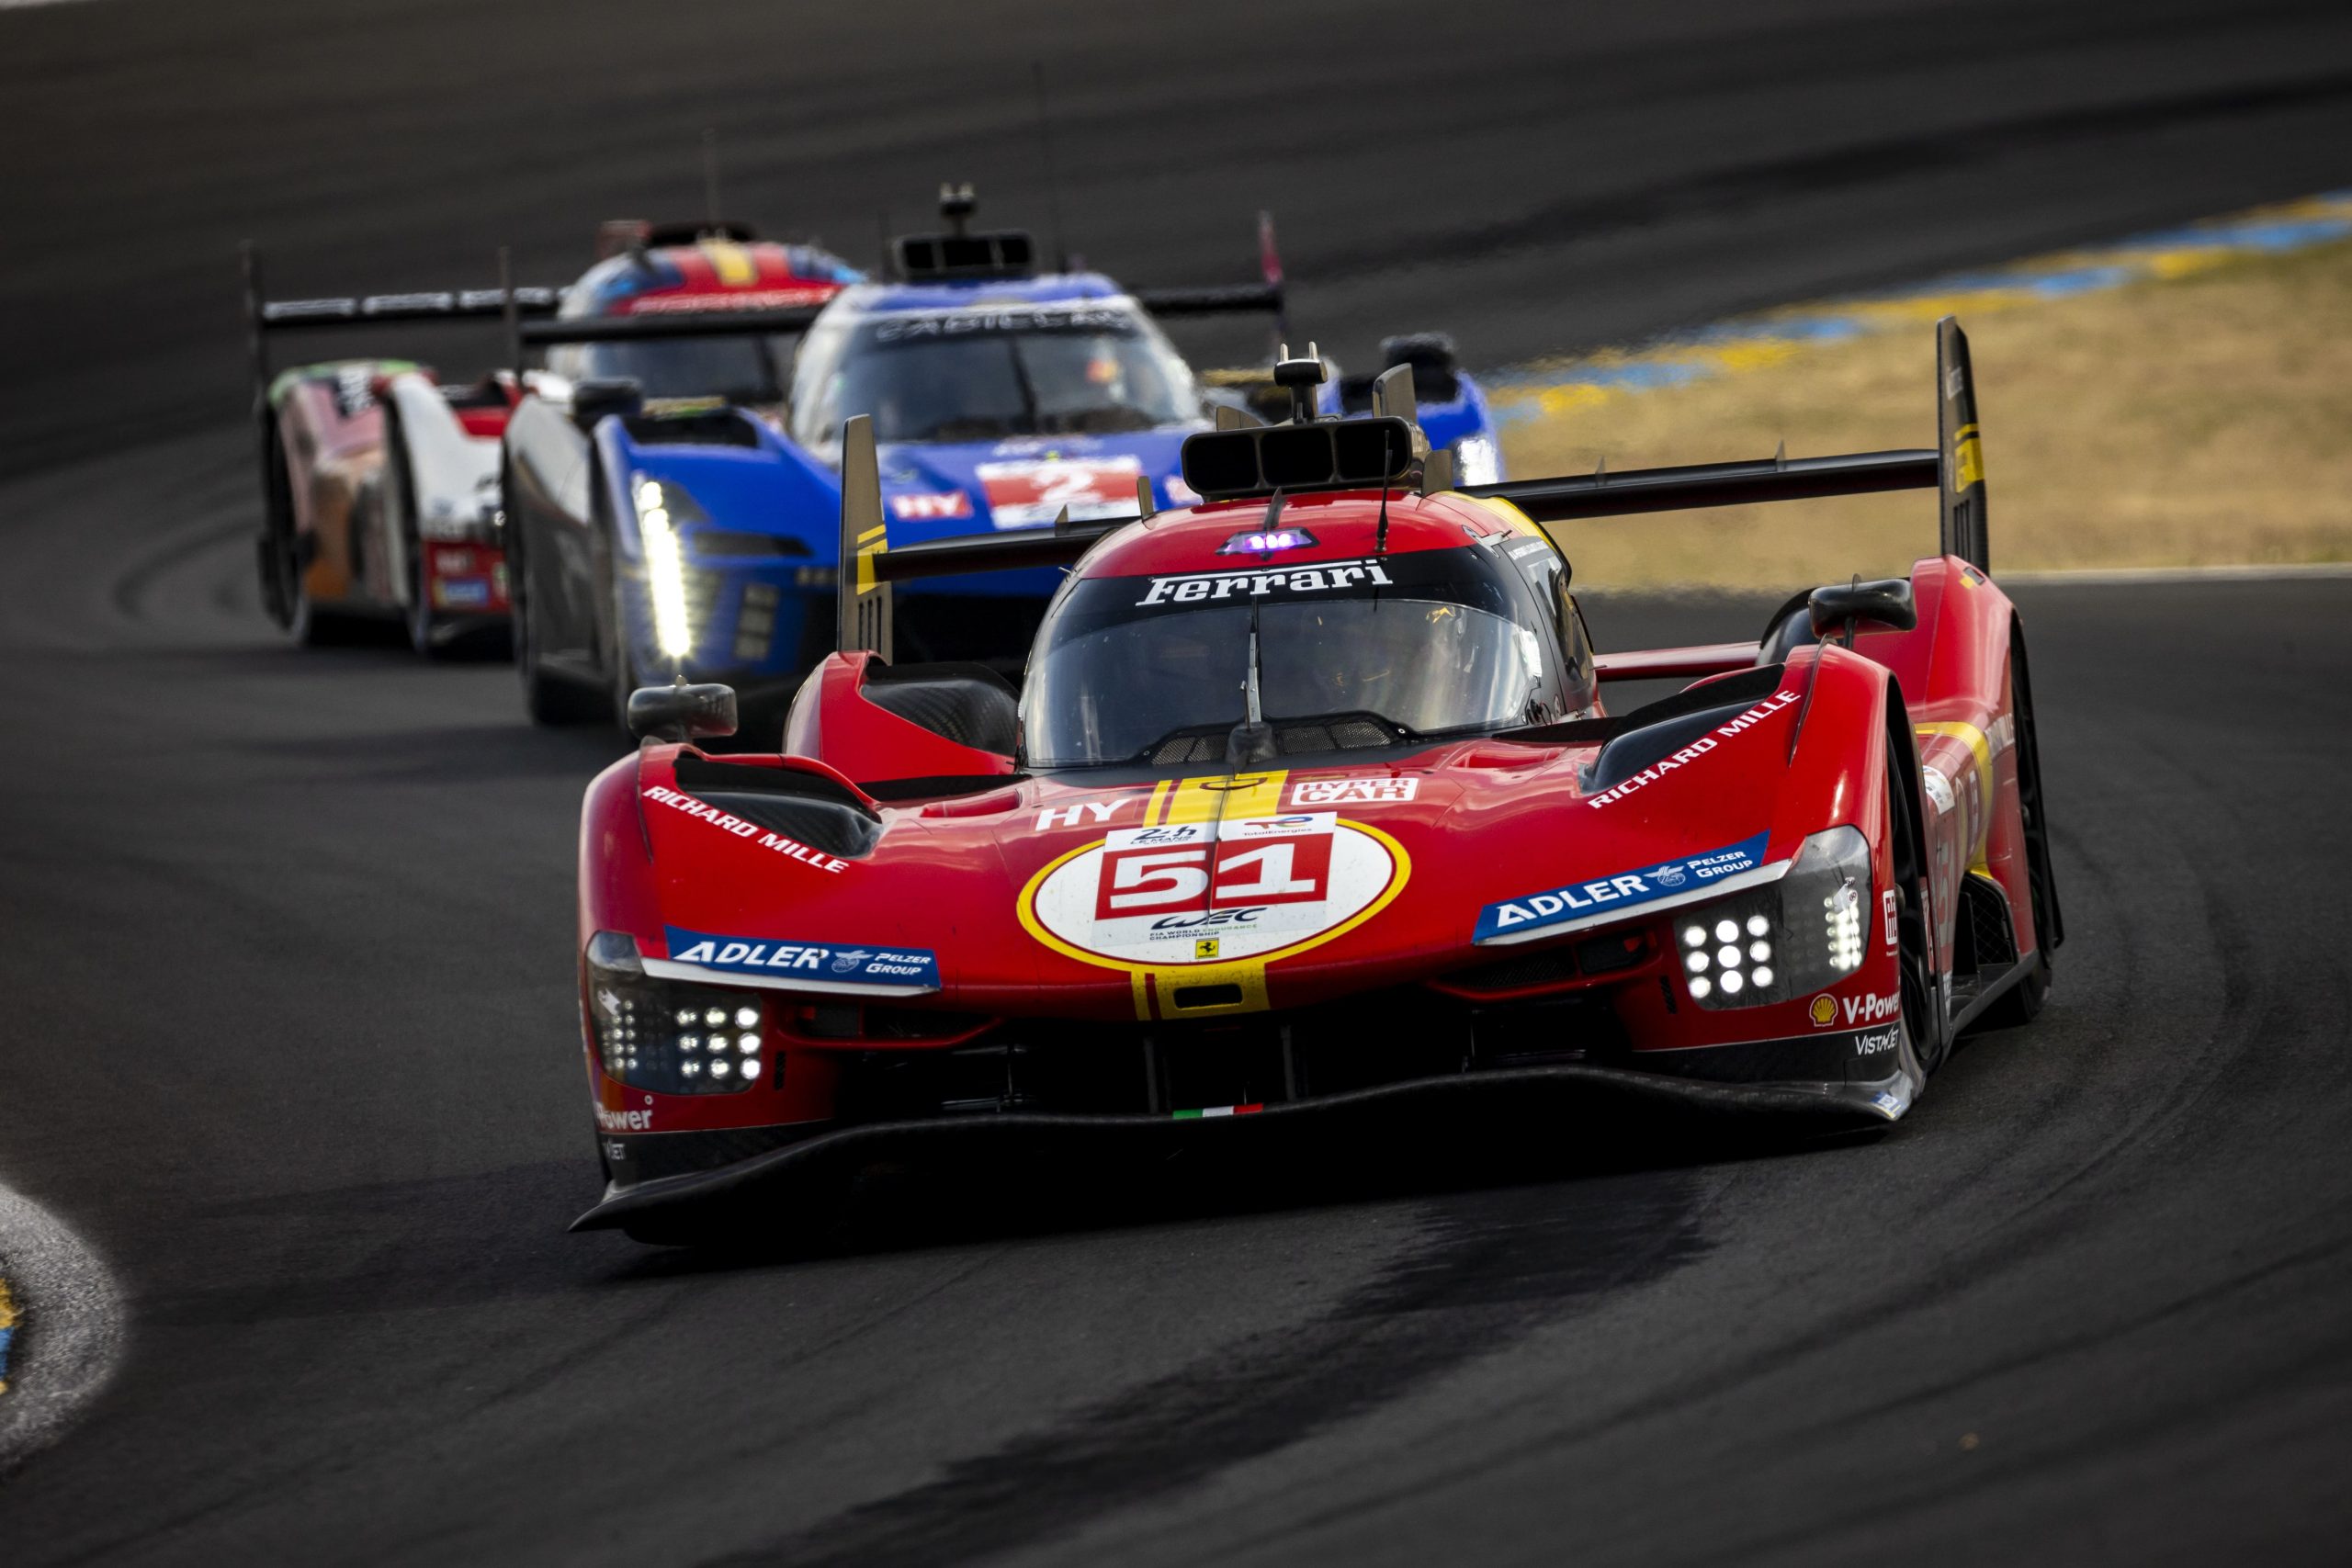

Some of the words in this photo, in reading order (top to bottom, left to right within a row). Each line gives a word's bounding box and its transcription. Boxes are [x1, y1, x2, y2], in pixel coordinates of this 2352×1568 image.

[1032, 469, 1102, 503] 2
[1135, 558, 1394, 607] Ferrari
[1588, 737, 1717, 809] RICHARD
[1717, 690, 1802, 739] MILLE
[1298, 786, 1407, 803] CAR
[1302, 778, 1410, 791] HYPER
[643, 785, 759, 838] RICHARD
[758, 833, 850, 874] MILLE
[1035, 798, 1131, 831] HY
[1243, 828, 1313, 837] TotalEnergies
[1110, 842, 1317, 909] 51
[1496, 874, 1651, 928] ADLER
[1150, 907, 1268, 930] WEC
[1203, 924, 1259, 932] ENDURANCE
[1149, 931, 1220, 941] CHAMPIONSHIP
[672, 941, 831, 970] ADLER
